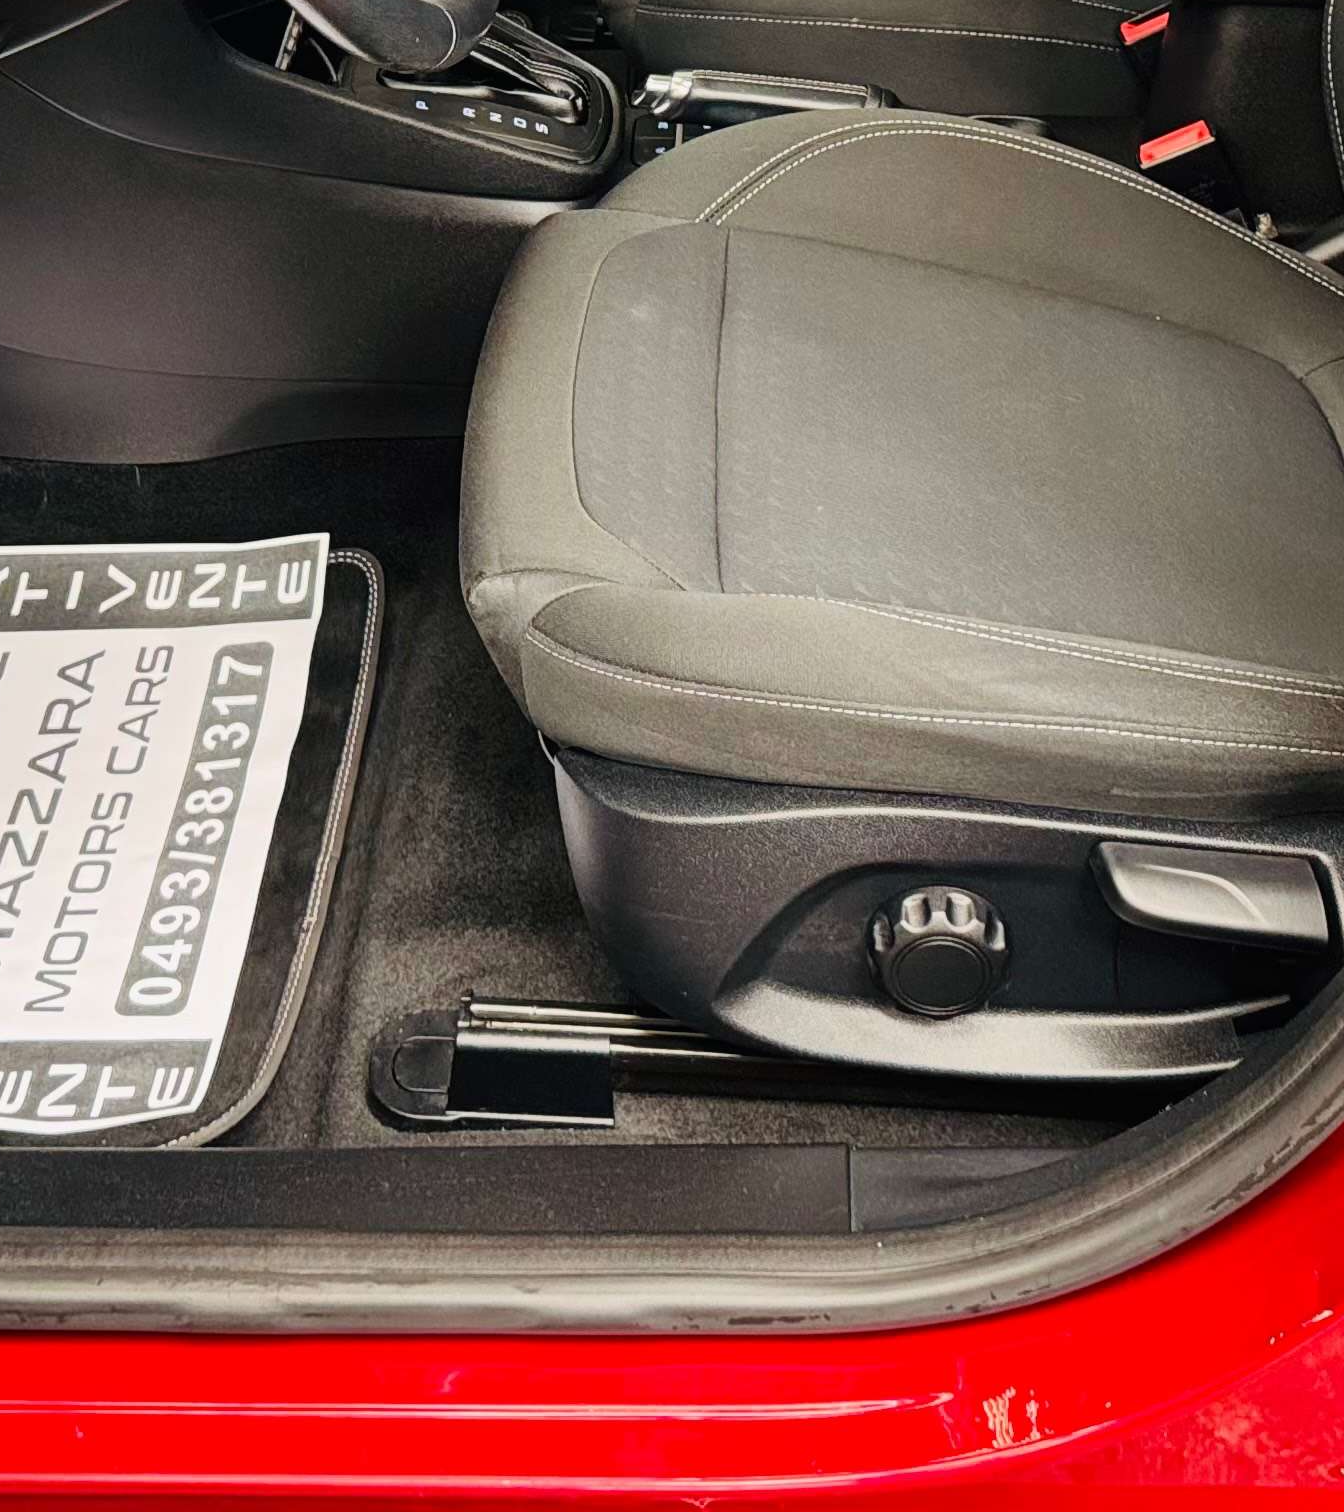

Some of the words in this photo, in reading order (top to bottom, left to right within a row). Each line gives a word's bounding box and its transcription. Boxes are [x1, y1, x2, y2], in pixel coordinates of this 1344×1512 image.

[23, 791, 134, 1012] MOTORS
[106, 645, 175, 775] CARS
[128, 654, 266, 1006] 0493/381317
